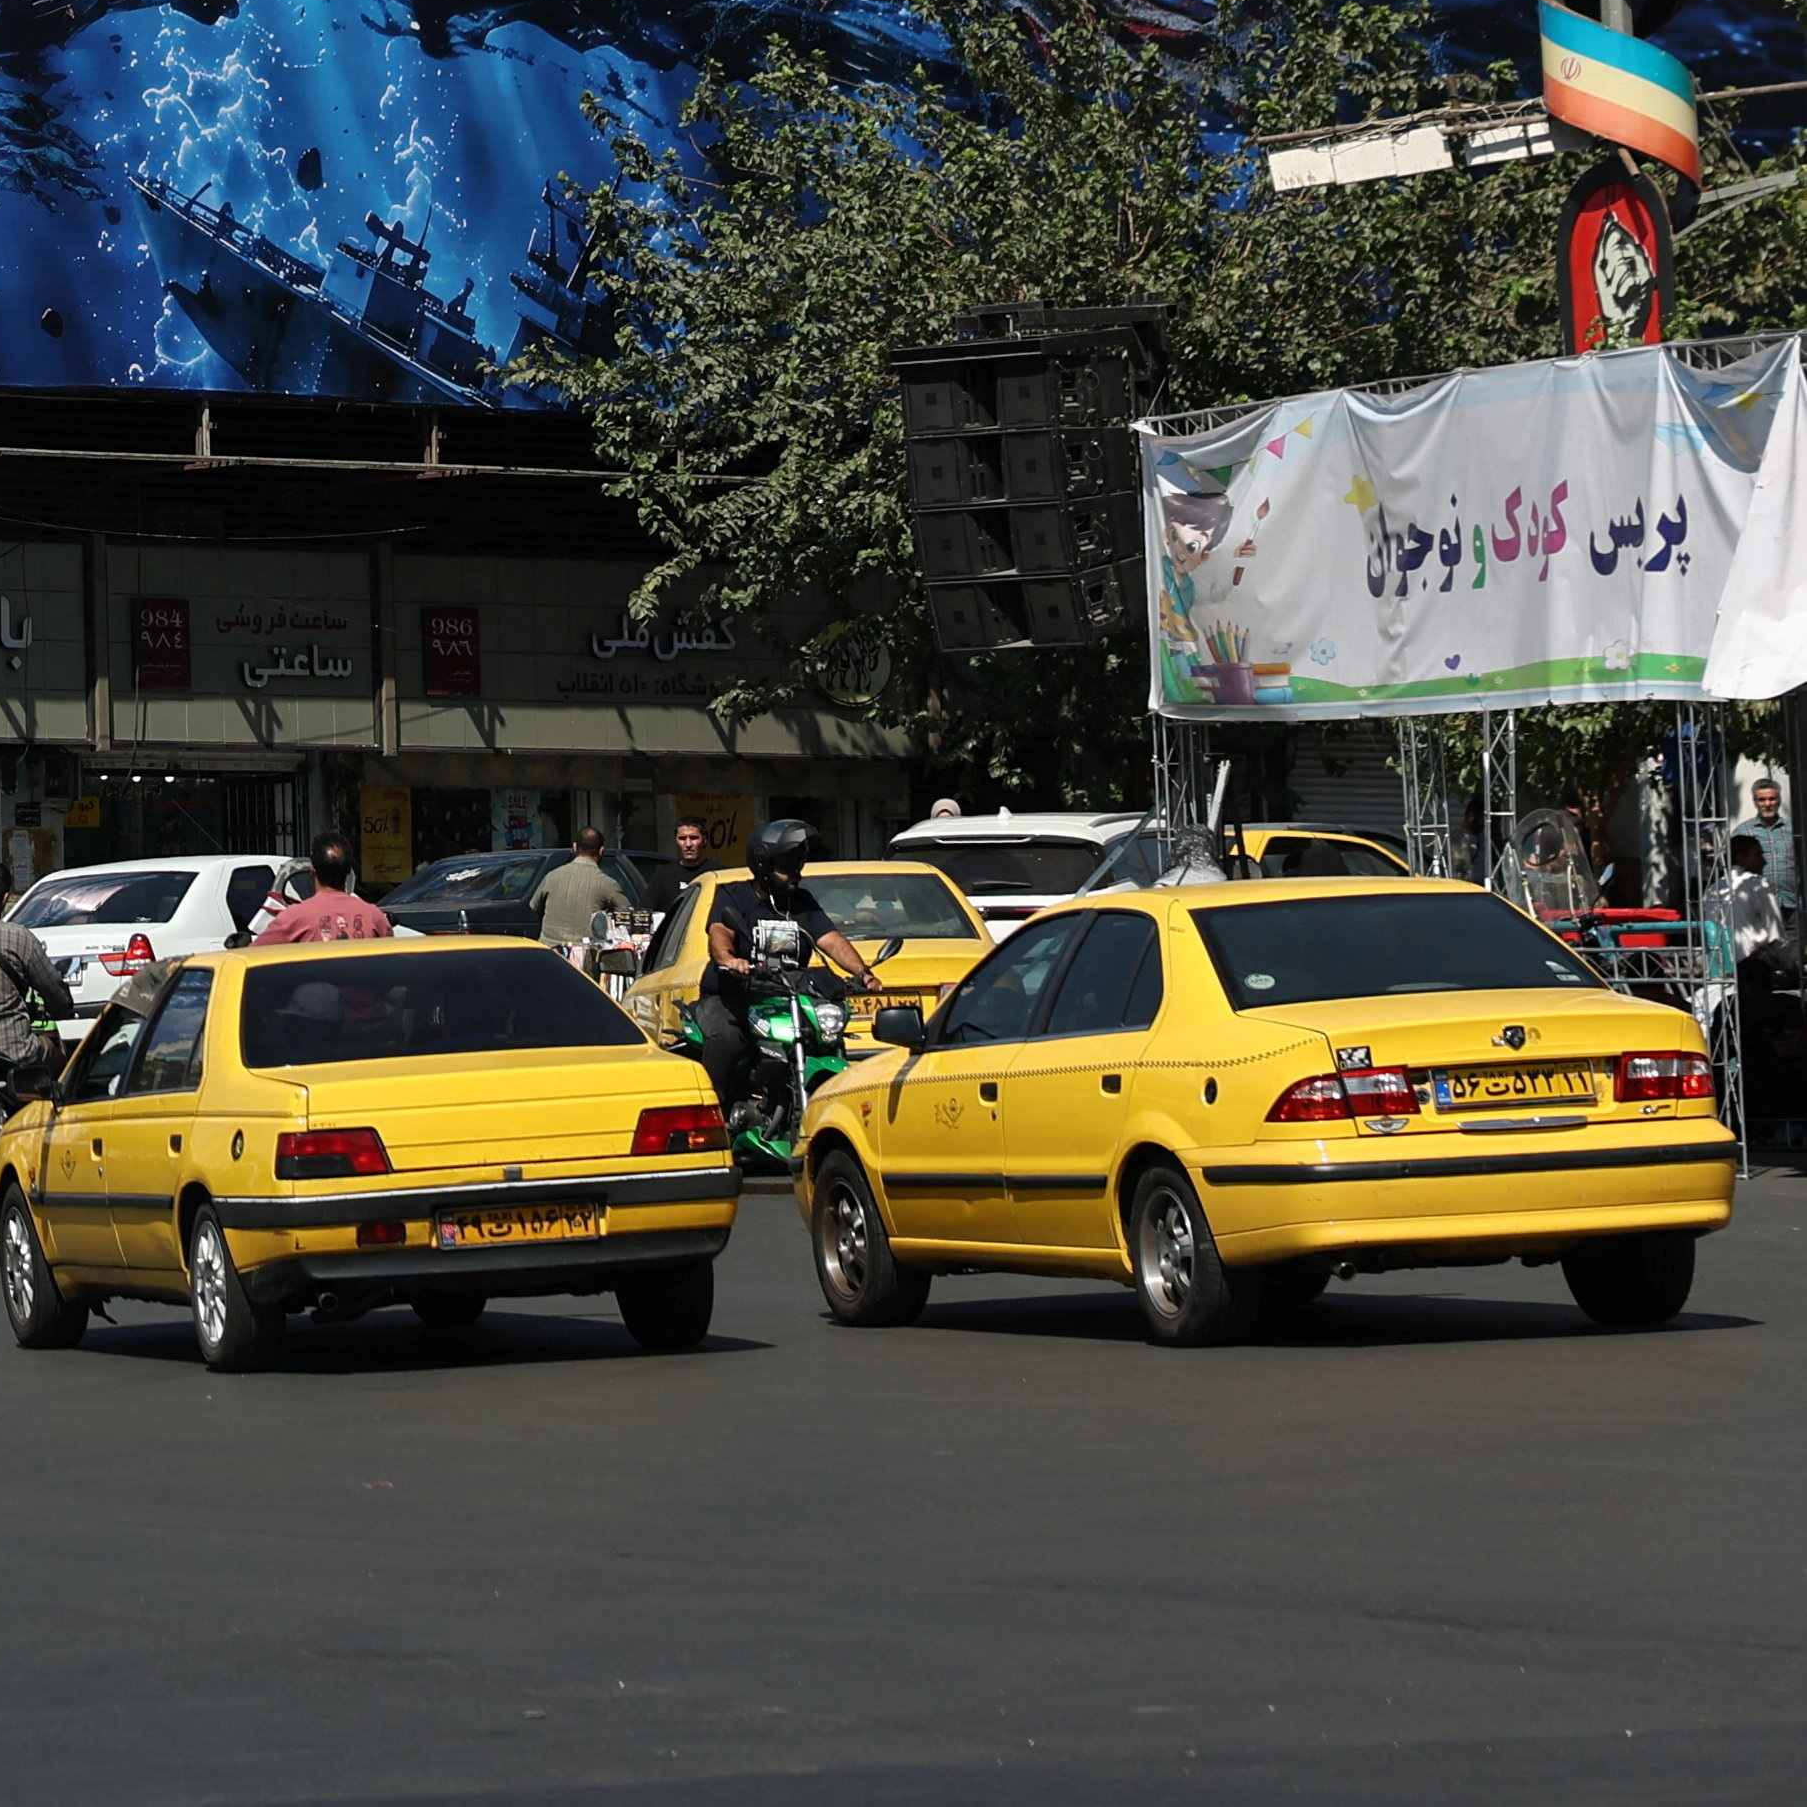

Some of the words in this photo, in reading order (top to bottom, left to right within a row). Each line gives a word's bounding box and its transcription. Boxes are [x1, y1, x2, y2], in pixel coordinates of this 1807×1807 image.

[1366, 492, 1464, 599] نوجوان
[1490, 478, 1569, 583] کودک
[1471, 523, 1487, 590] و
[139, 608, 184, 628] 984
[215, 603, 287, 634] فروشی
[289, 609, 349, 630] ساعت
[430, 617, 473, 635] 986
[591, 614, 651, 659] ملی
[653, 609, 738, 662] کفش
[243, 643, 354, 688] ساعتی
[506, 794, 528, 810] SALE
[1452, 1073, 1480, 1099] ۵۶
[1485, 1081, 1510, 1096] ت
[1513, 1068, 1555, 1095] ۵۳۳
[1562, 1070, 1589, 1094] ۱۱
[487, 1222, 513, 1238] ت
